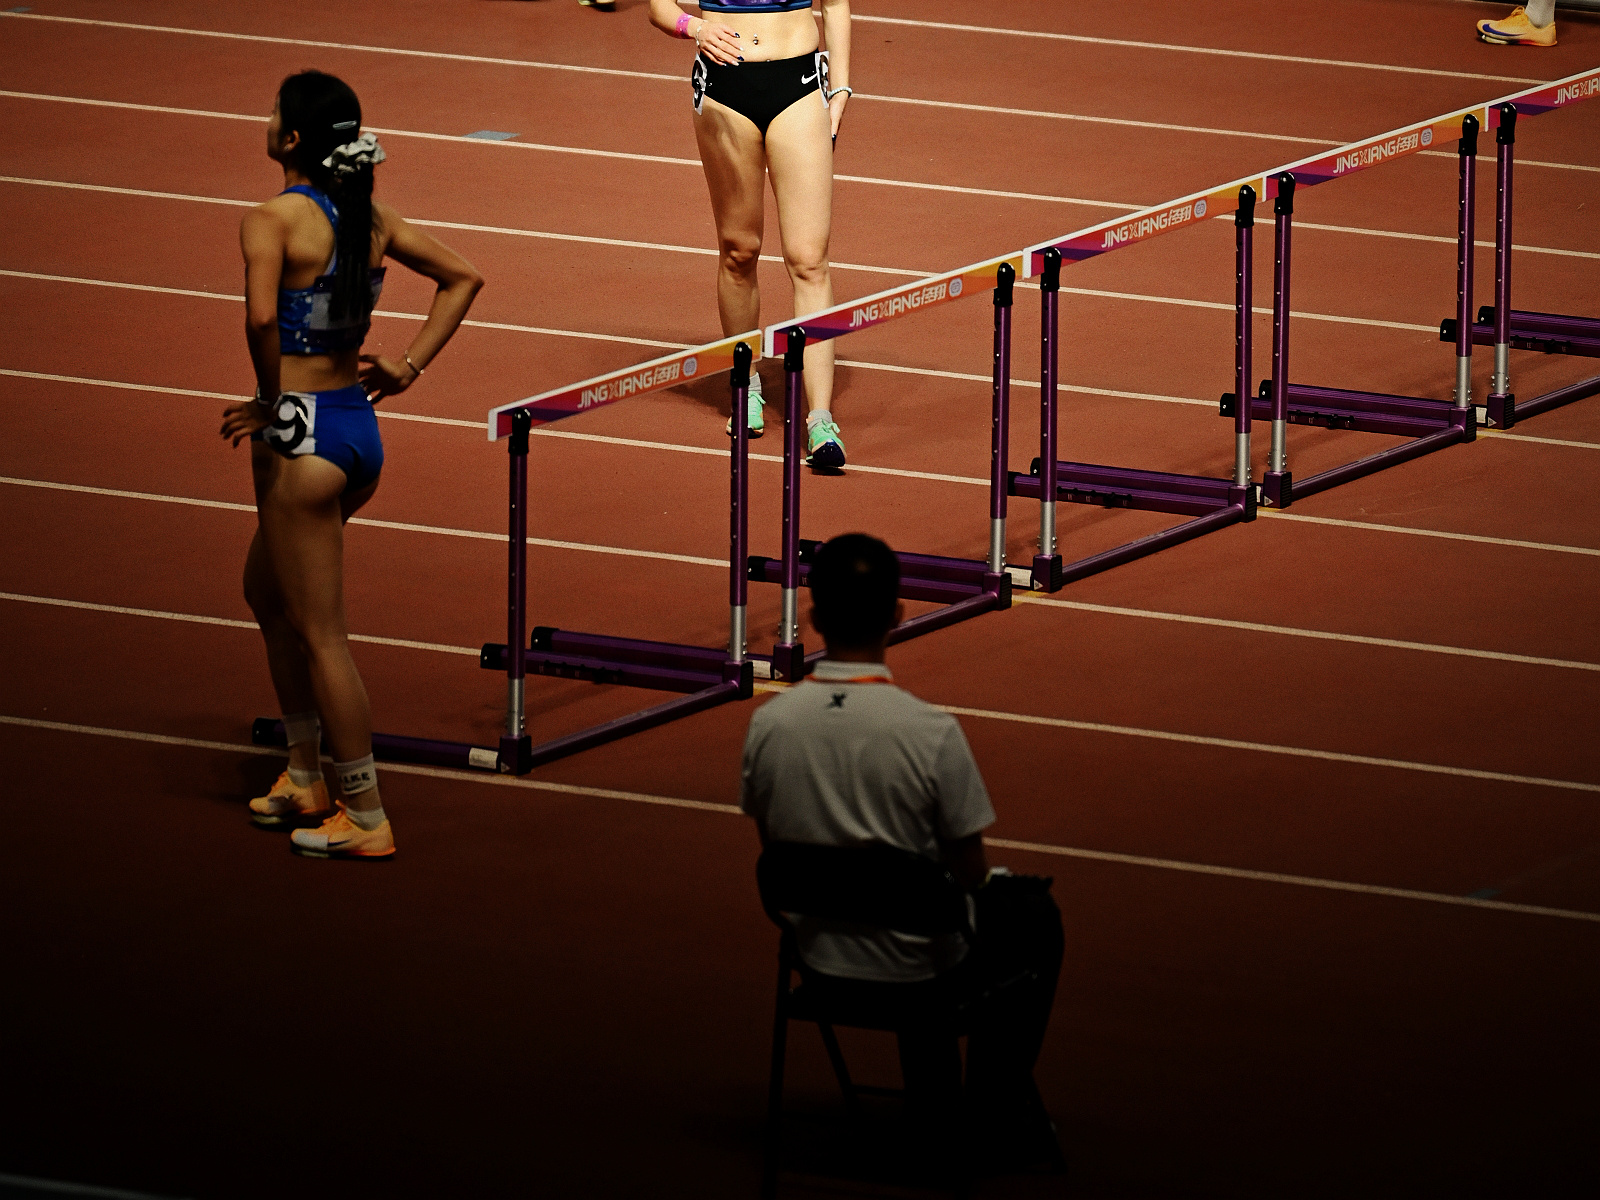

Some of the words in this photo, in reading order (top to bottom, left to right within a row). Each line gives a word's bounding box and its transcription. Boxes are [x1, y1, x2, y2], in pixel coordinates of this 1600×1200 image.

[1554, 77, 1600, 104] JINGXIA
[1333, 140, 1396, 173] JINGXIANG
[1101, 212, 1168, 248] JINGXIANG
[849, 291, 921, 327] JINGXIANG
[577, 371, 653, 408] JINGXIANG
[269, 395, 308, 452] 9
